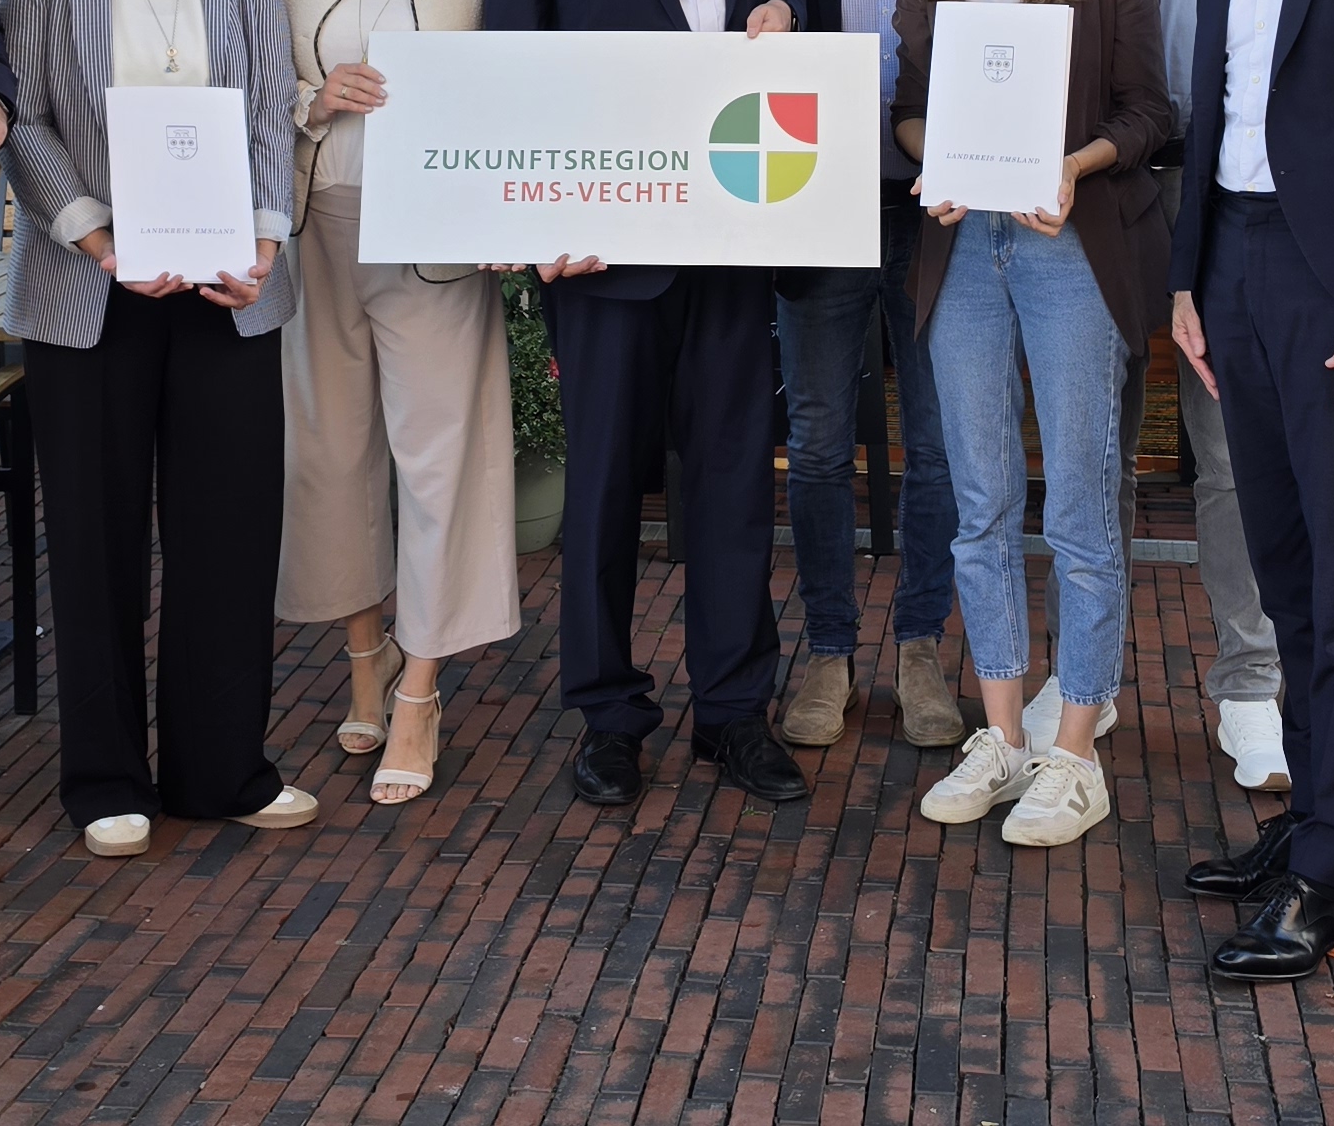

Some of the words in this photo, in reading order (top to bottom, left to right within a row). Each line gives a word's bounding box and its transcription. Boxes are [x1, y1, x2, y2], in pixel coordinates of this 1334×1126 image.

[422, 148, 690, 172] ZUKUNFTSREGION
[946, 152, 996, 162] LANDKREIS
[998, 155, 1041, 165] EMSLAND
[502, 180, 689, 204] EMS-VECHTE
[140, 226, 192, 235] LANDKREIS
[194, 227, 237, 235] EMSLAND
